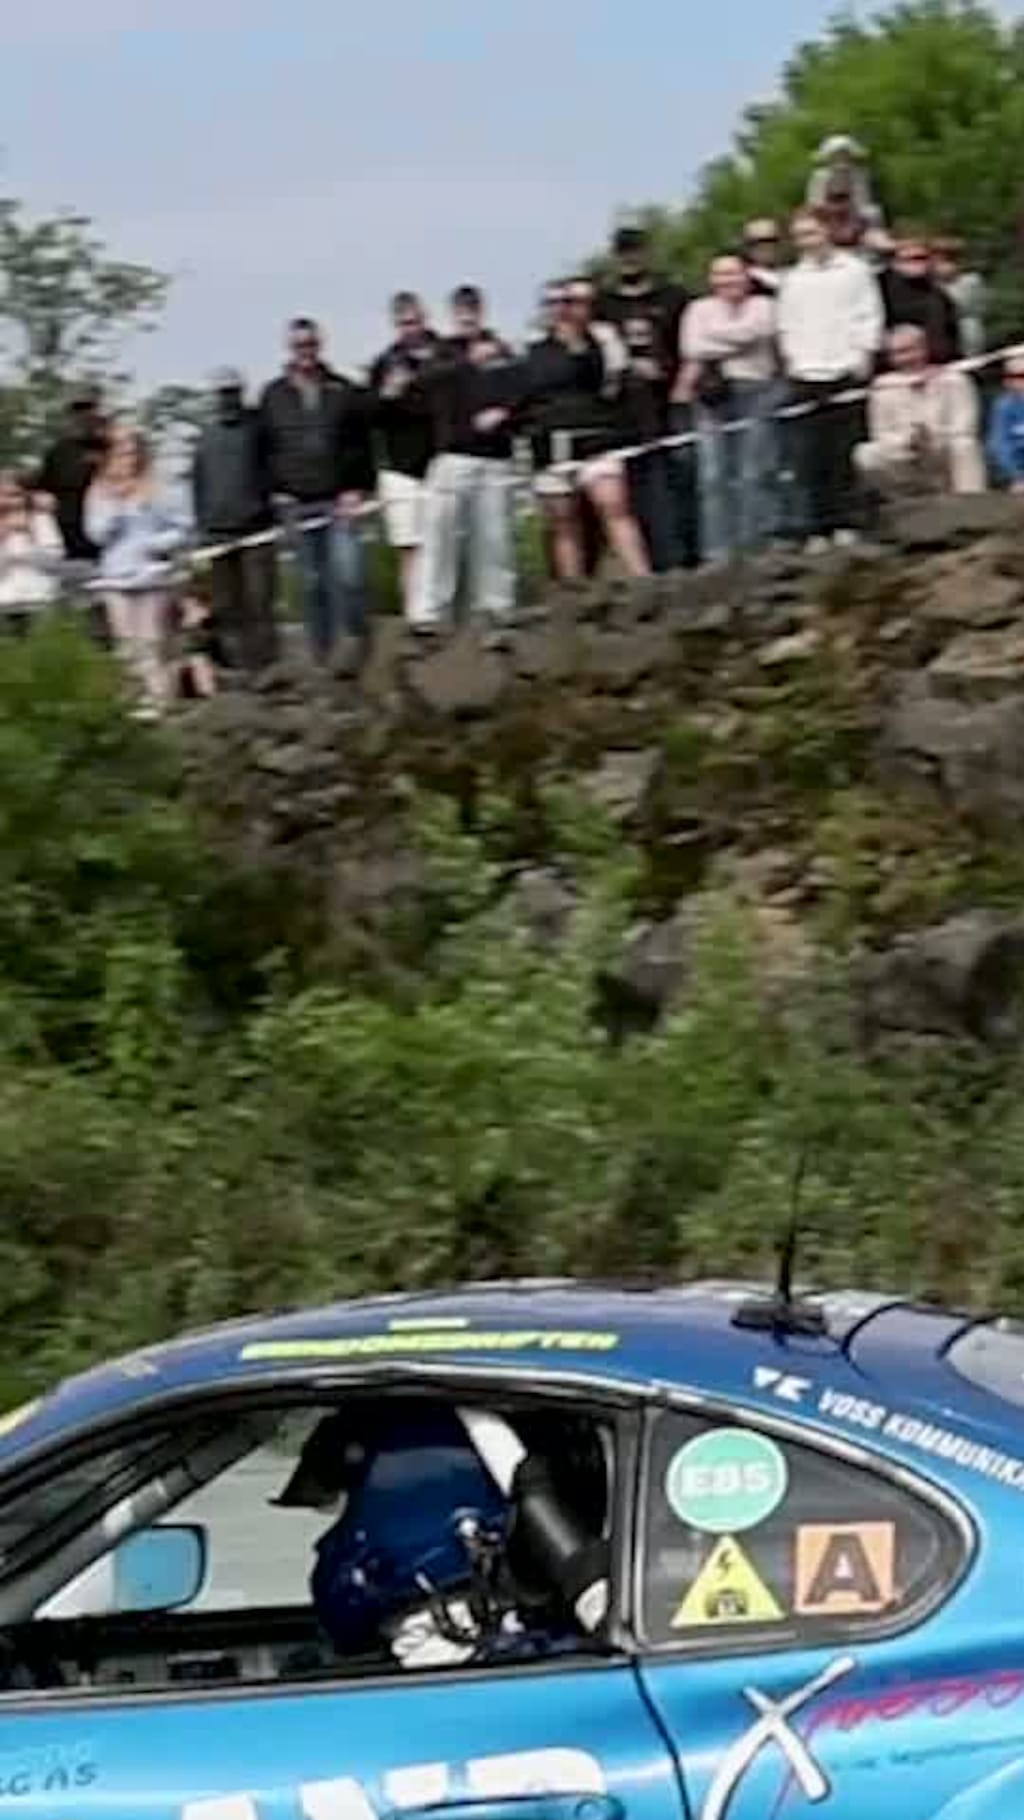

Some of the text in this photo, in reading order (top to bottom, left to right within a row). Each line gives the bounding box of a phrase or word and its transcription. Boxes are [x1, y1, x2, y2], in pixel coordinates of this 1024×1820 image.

[817, 1387, 887, 1428] VOSS
[803, 1533, 882, 1606] A
[43, 1762, 100, 1791] AS
